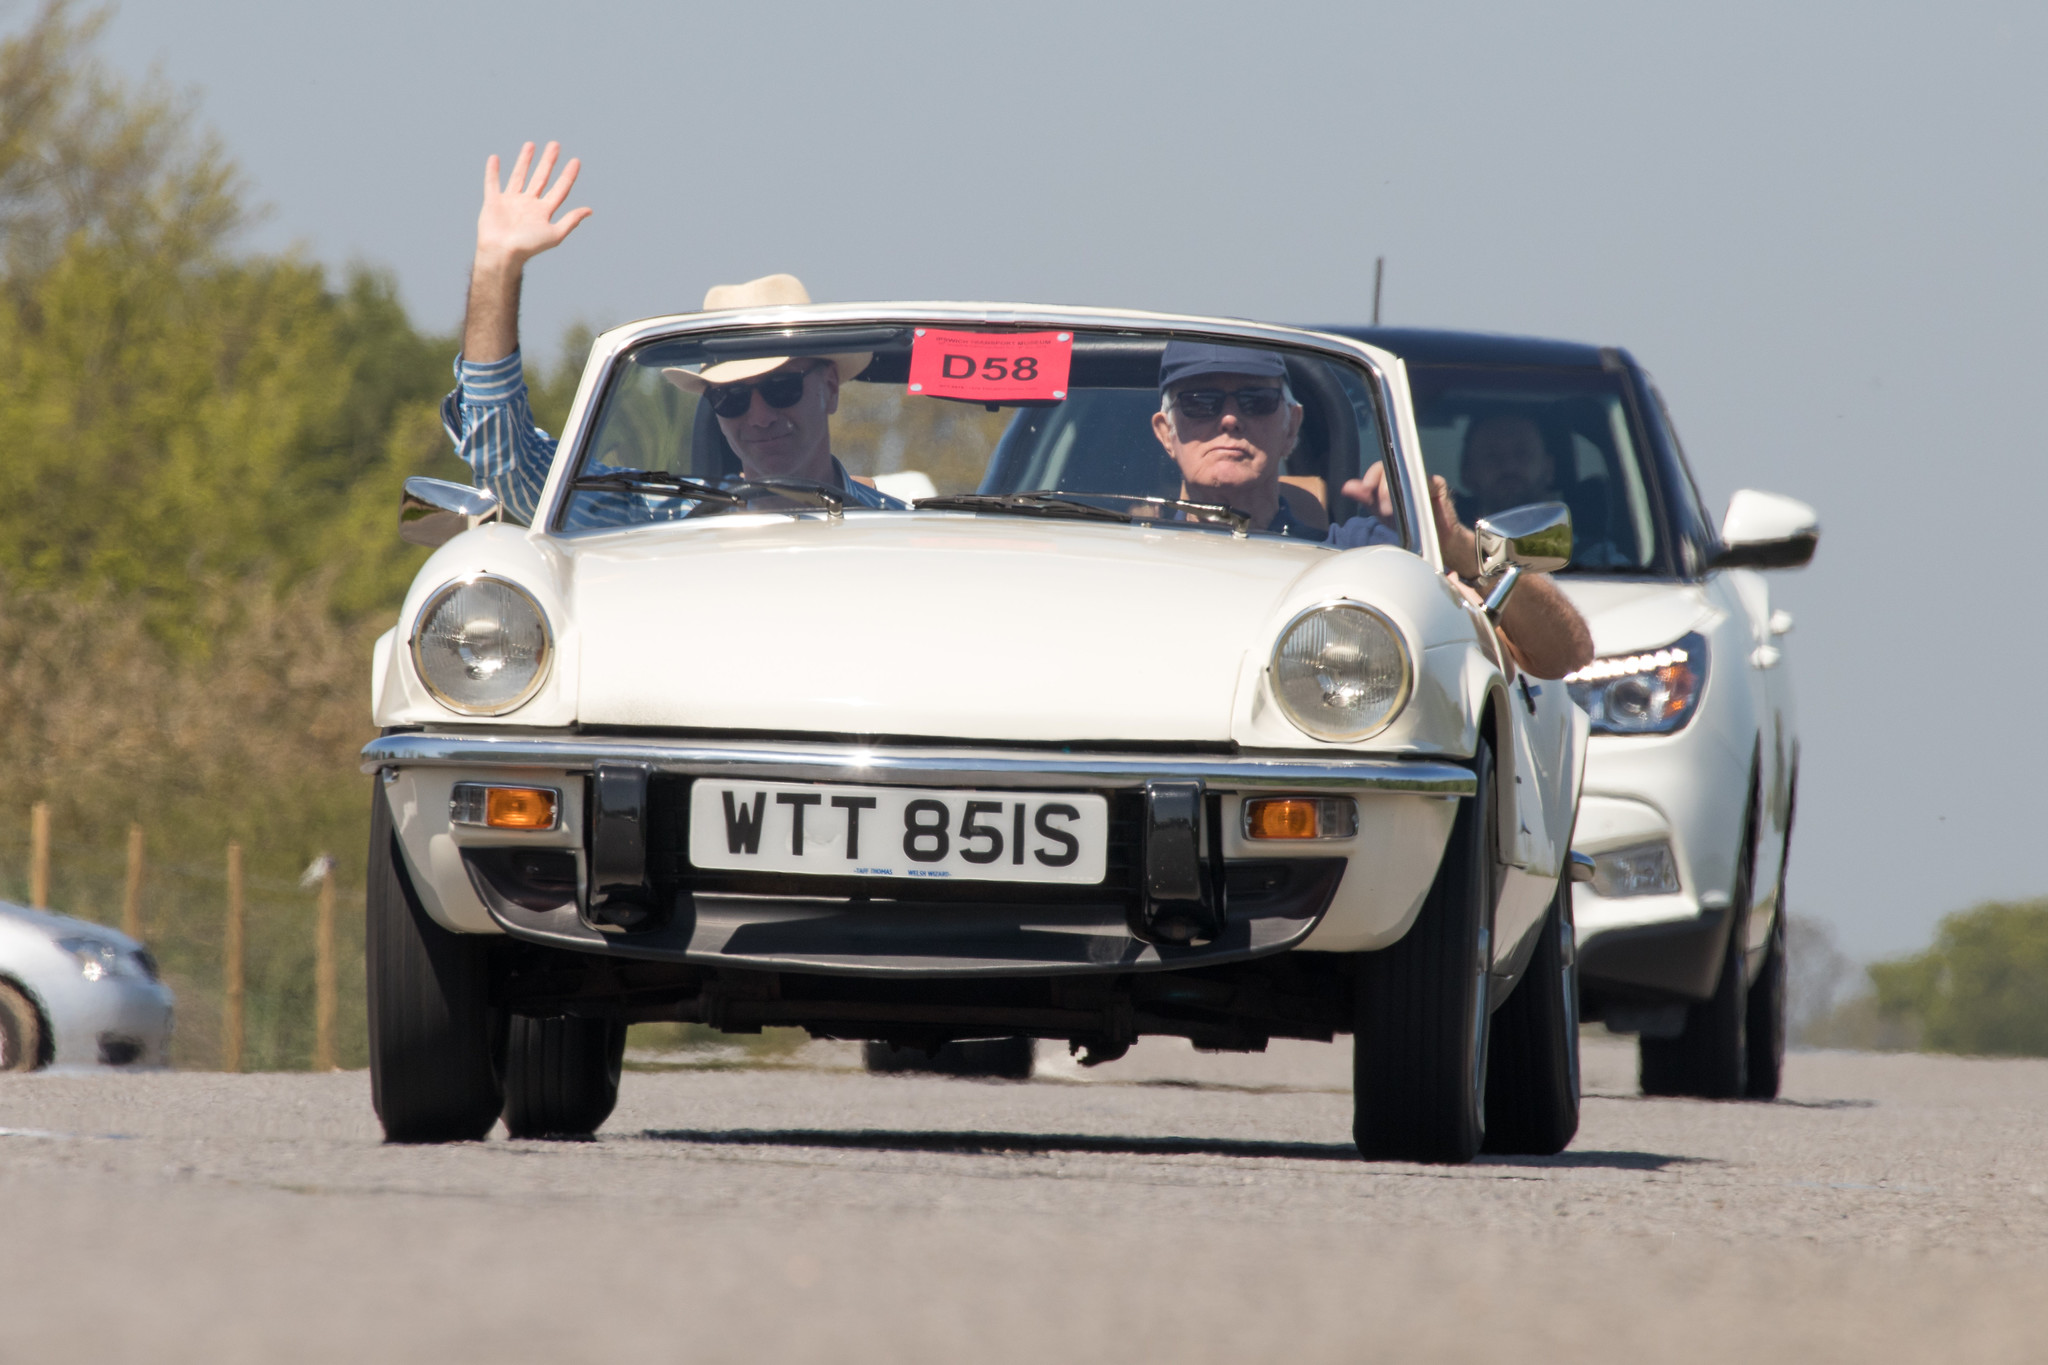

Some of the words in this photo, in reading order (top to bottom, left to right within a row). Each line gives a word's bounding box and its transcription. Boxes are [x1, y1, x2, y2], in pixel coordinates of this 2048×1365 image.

[942, 354, 1038, 381] D58
[721, 790, 877, 859] WTT
[903, 799, 1081, 867] 851S
